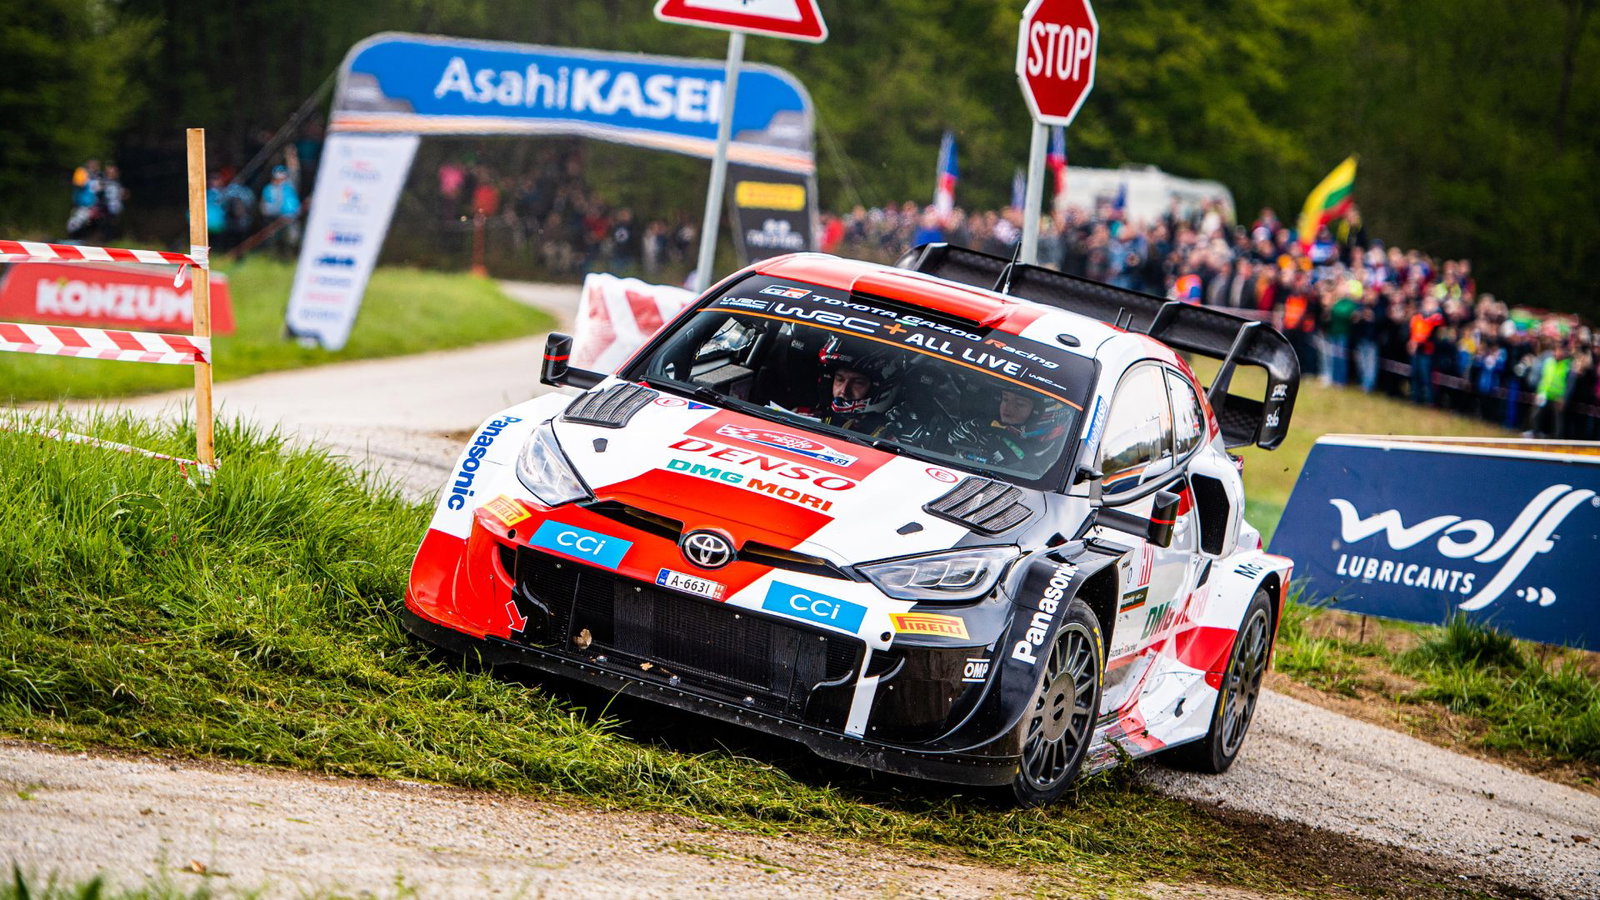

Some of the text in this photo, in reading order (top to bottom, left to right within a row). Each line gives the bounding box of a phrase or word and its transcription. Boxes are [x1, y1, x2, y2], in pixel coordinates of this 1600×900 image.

[1028, 20, 1092, 82] STOP
[433, 56, 726, 124] AsahiKASEI
[763, 285, 1060, 371] GR TOYOTA GAZOO Racing
[774, 303, 881, 334] WRC
[904, 333, 954, 356] ALL
[961, 348, 1022, 376] LIVE
[447, 414, 524, 511] Panasonic
[666, 458, 833, 512] DMG MORI
[668, 438, 856, 491] DENSO
[1335, 553, 1476, 595] LUBRICANTS
[896, 615, 962, 635] PIRELLI
[1011, 562, 1080, 665] Panasonic
[963, 661, 989, 679] OMP
